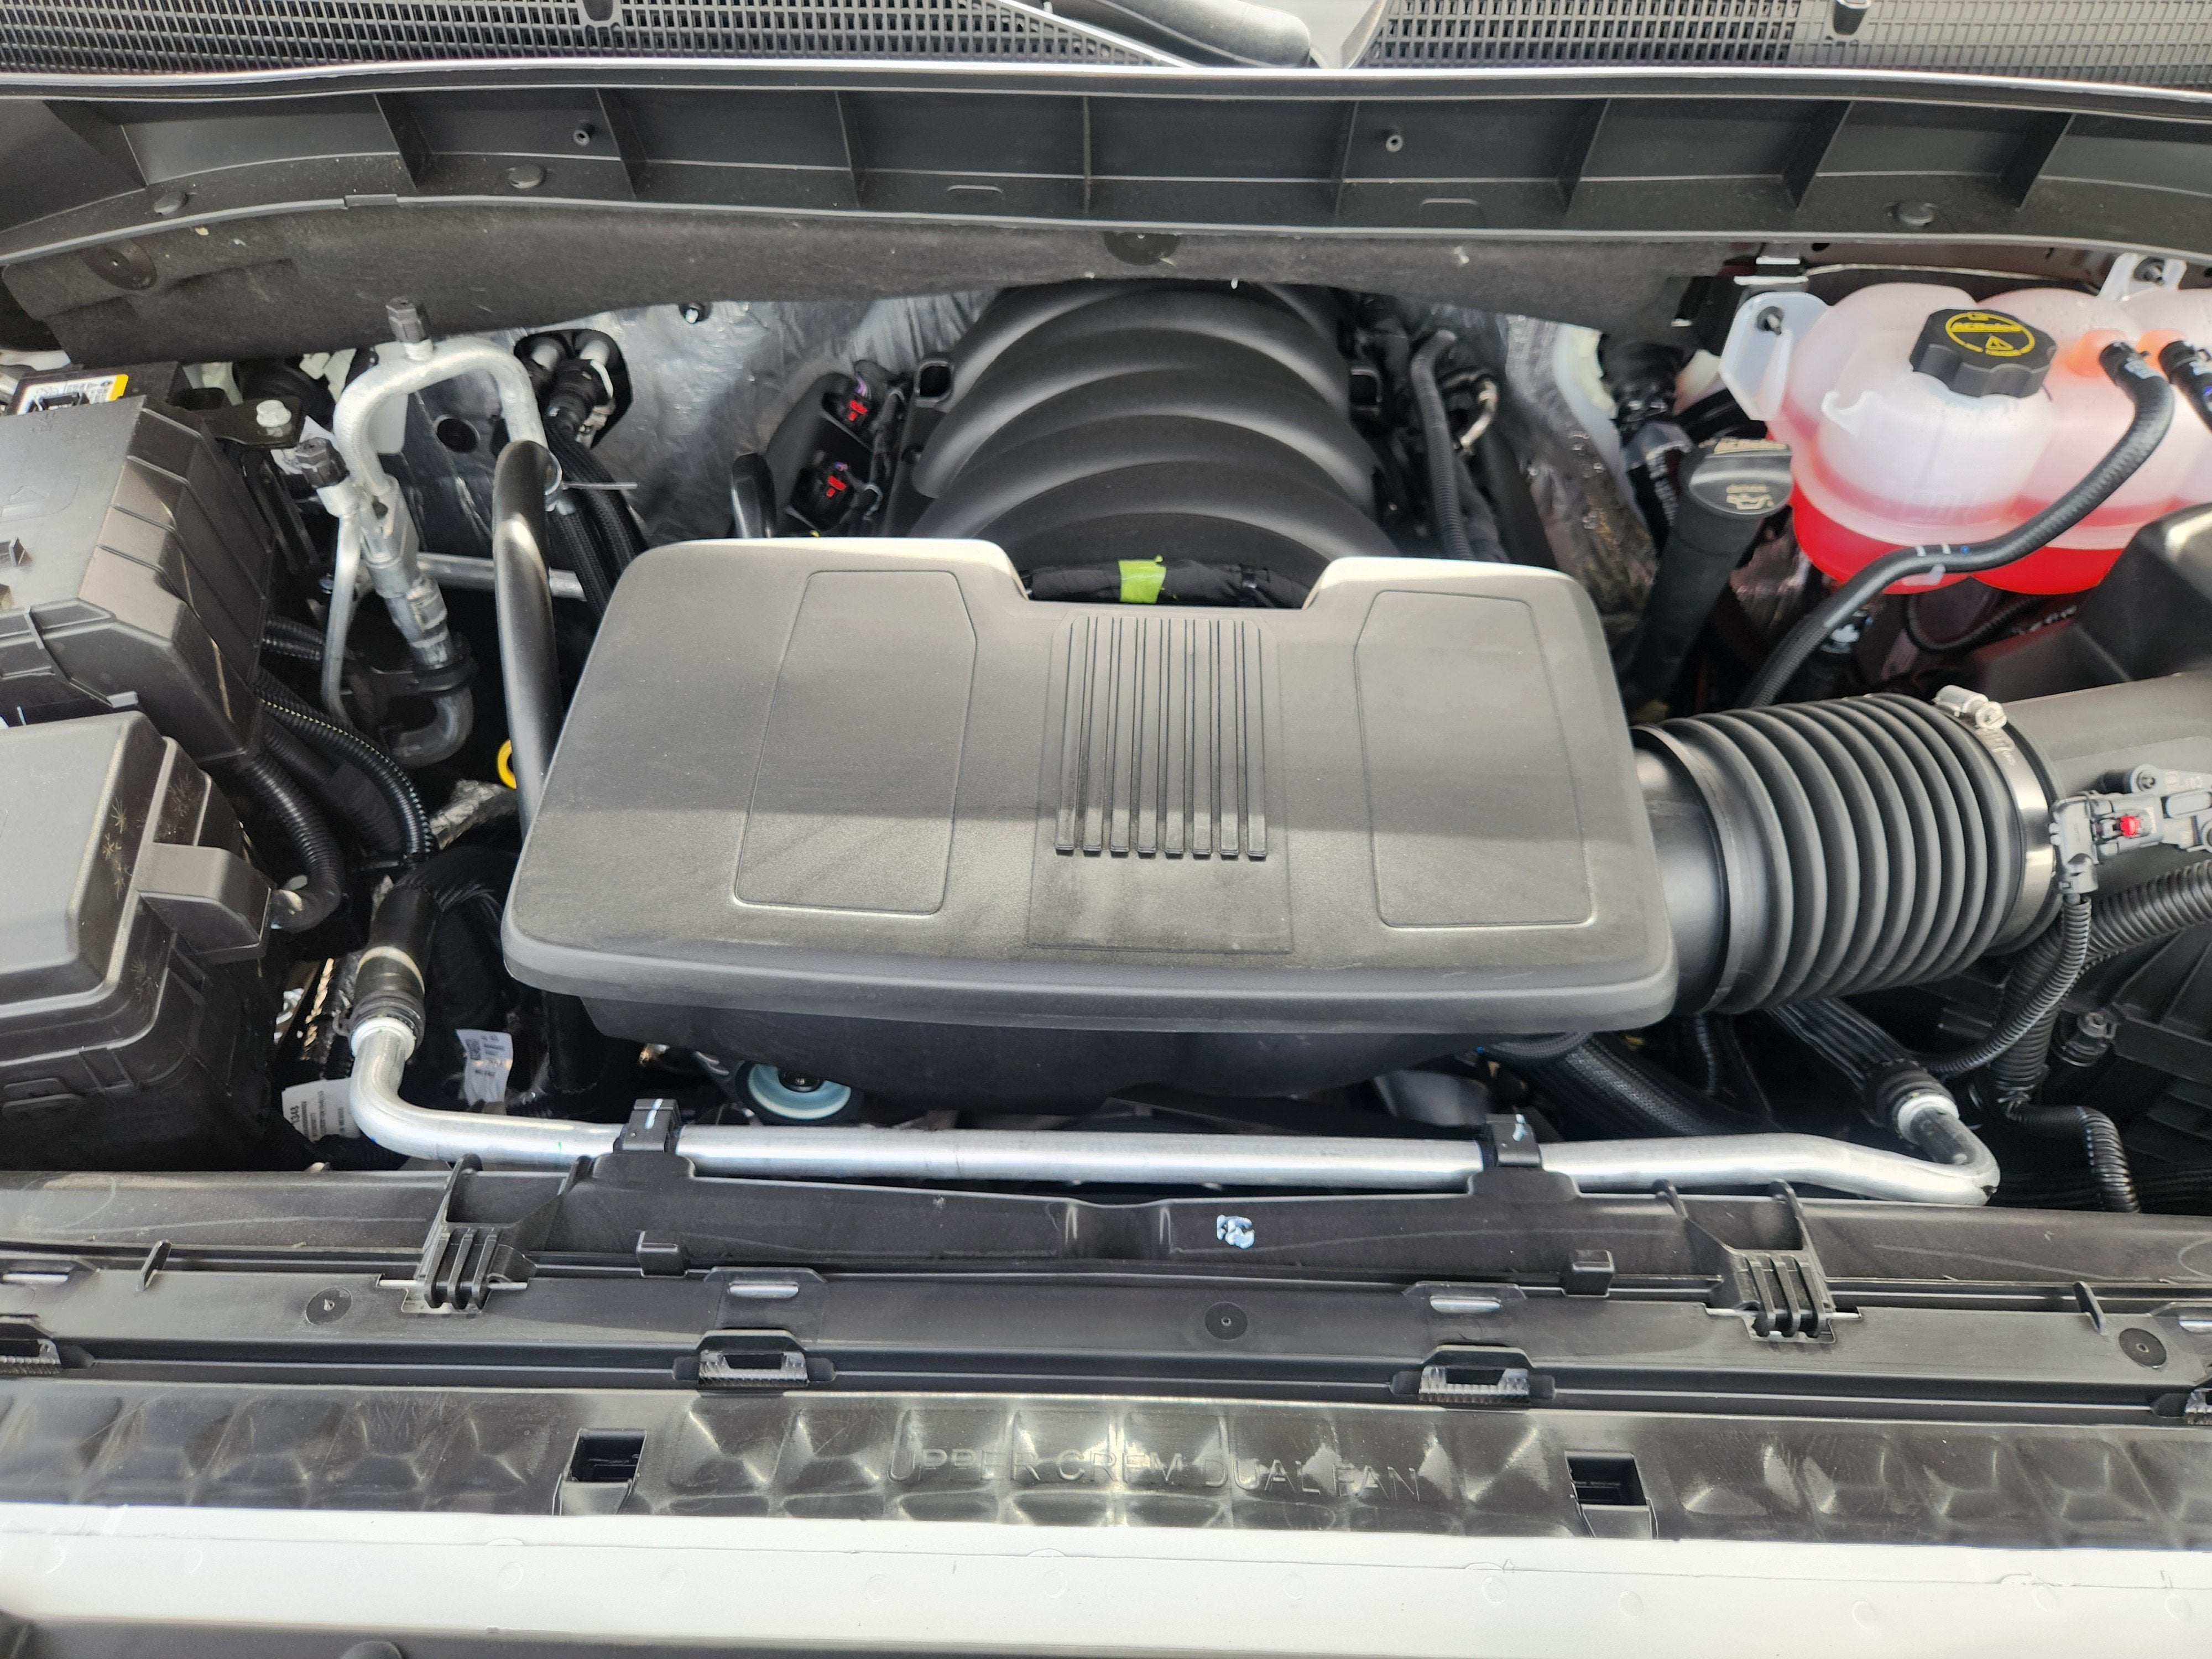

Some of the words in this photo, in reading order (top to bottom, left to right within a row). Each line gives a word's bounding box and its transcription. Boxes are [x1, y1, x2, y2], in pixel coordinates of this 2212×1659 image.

[886, 1448, 1041, 1482] UPPER
[1203, 1459, 1321, 1495] DUAL
[1332, 1463, 1420, 1502] FAN
